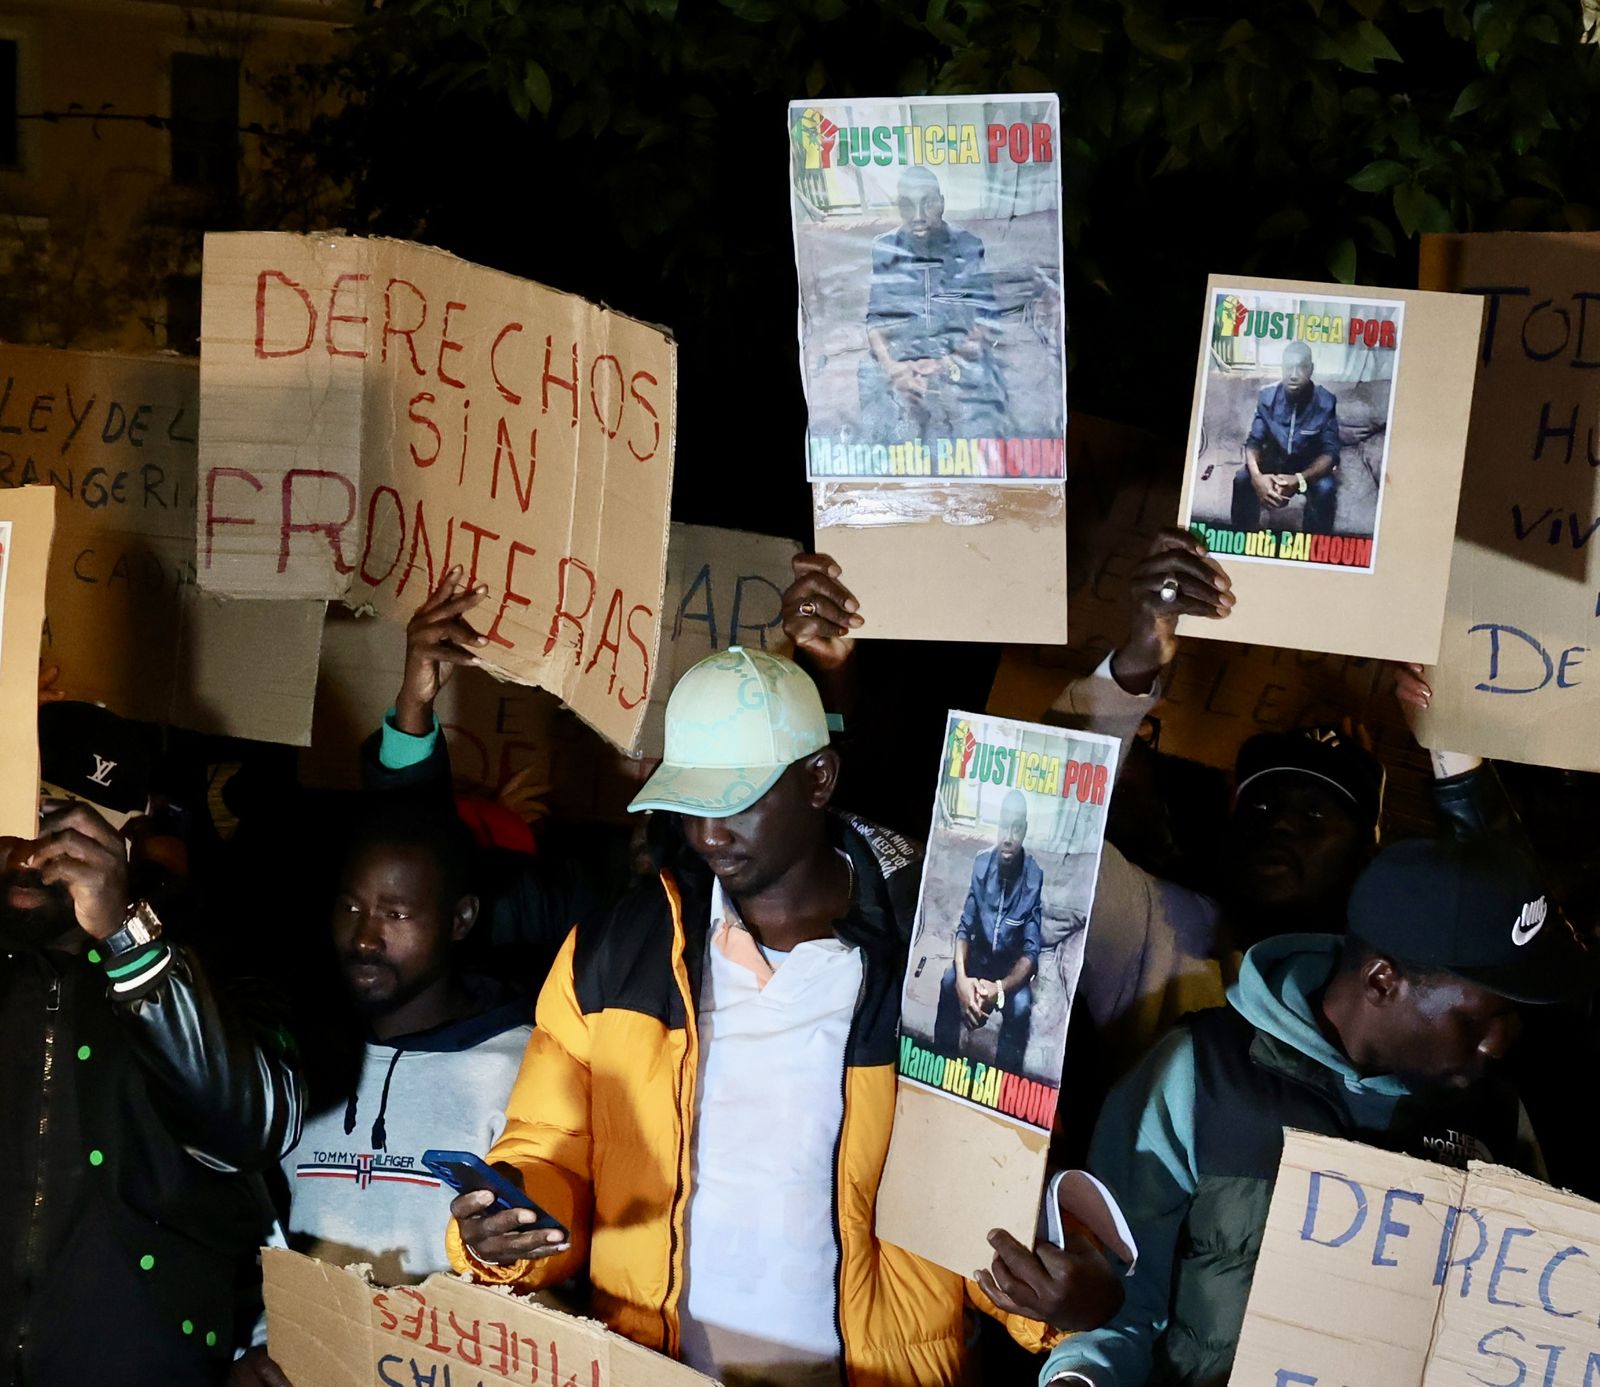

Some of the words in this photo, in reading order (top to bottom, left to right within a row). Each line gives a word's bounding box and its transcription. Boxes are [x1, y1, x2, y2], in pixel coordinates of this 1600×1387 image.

[836, 123, 981, 167] JUSTICIA
[986, 122, 1053, 164] POR
[1243, 309, 1345, 345] JUSTICIA
[1347, 317, 1397, 348] POR
[255, 270, 661, 461] DERECHOS
[0, 376, 96, 454] LEY
[102, 402, 153, 447] DE
[810, 437, 932, 477] Mamouth
[205, 466, 653, 710] FRONTERAS
[969, 742, 1060, 796] JUSTICIA
[1061, 759, 1109, 806] POR
[871, 835, 897, 856] KEEP
[900, 1035, 972, 1098] Mamouth
[313, 1151, 357, 1164] TOMMY
[1299, 1170, 1600, 1328] DEREC
